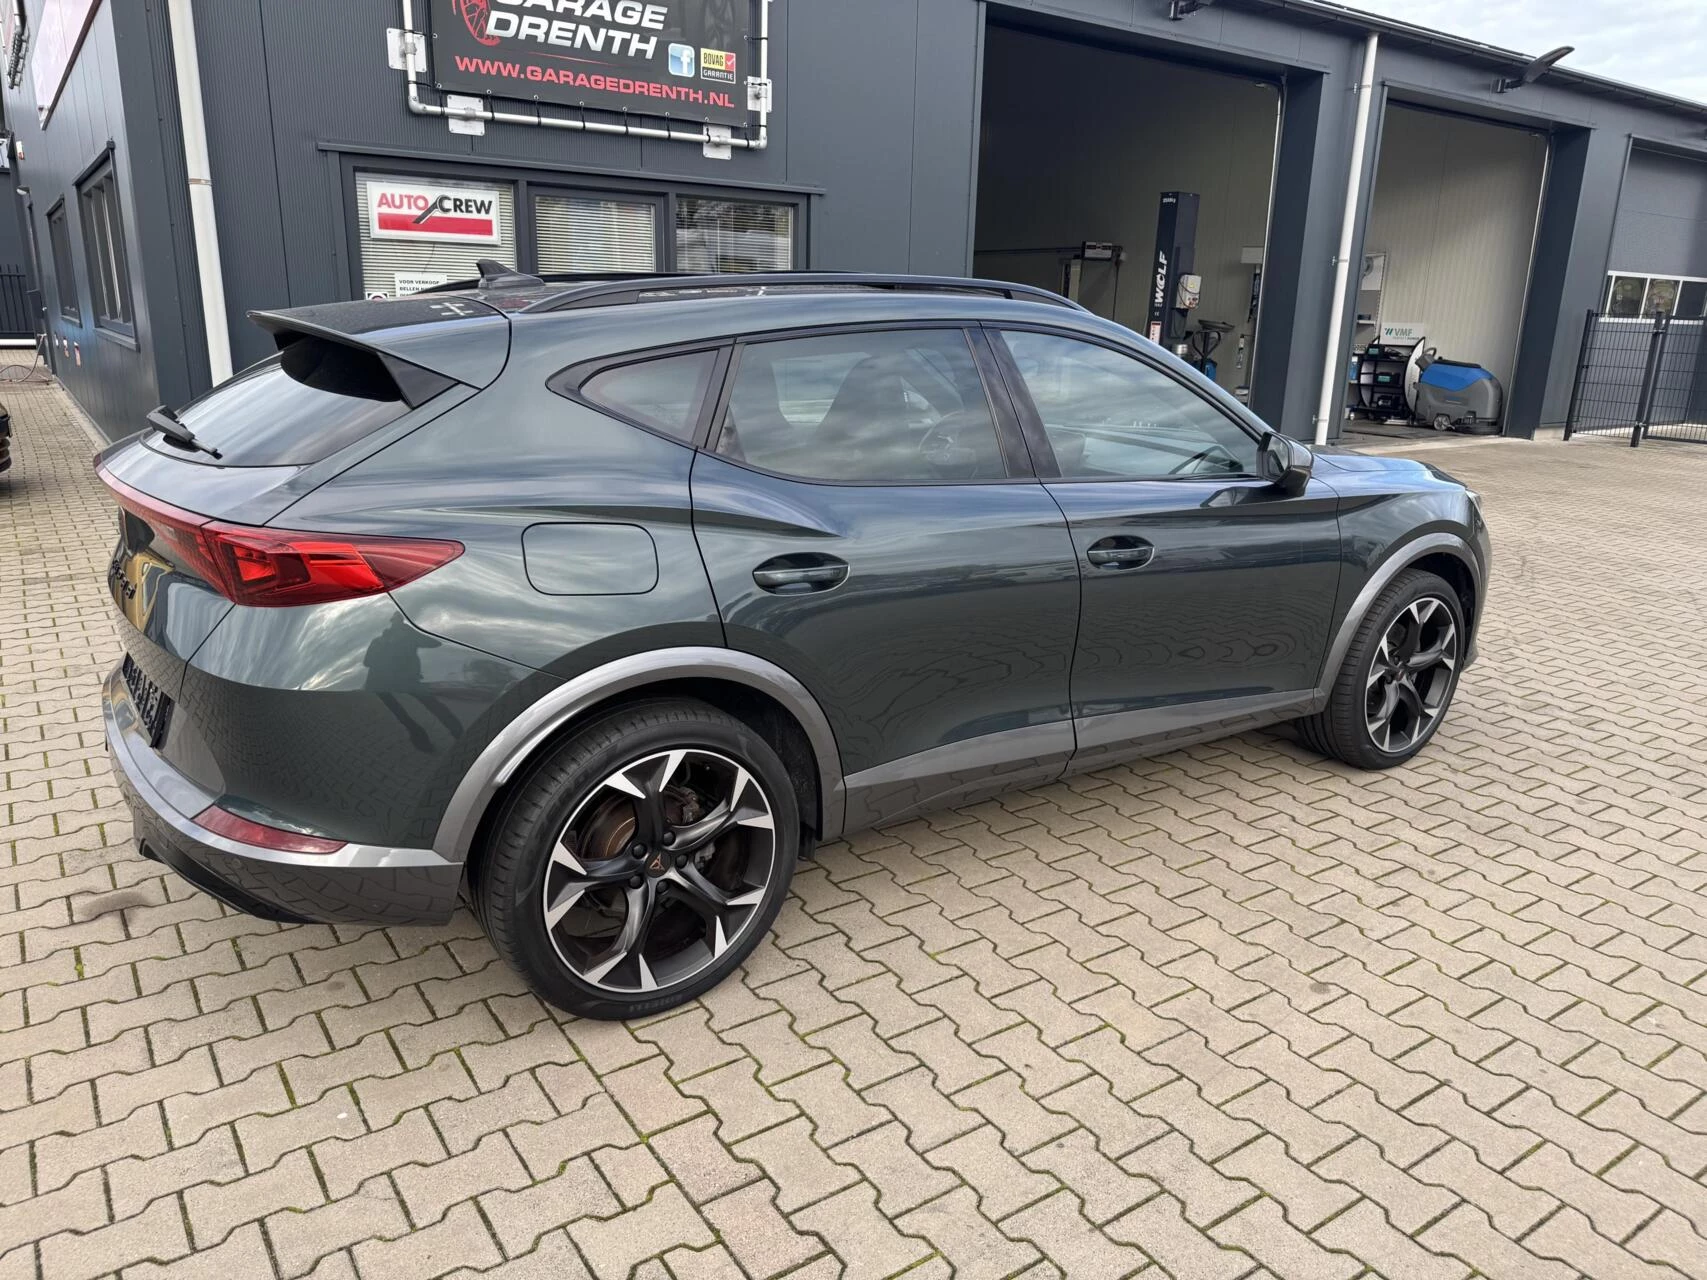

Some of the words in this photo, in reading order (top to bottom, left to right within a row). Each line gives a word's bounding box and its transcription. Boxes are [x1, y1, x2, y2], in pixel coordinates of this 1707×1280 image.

[496, 0, 668, 30] RAGE
[485, 10, 658, 59] DRENTH
[703, 52, 724, 67] BOVAG
[455, 56, 734, 107] WWW.GARAGEDRENTH.NL
[703, 69, 734, 81] GARANTIE
[377, 192, 429, 211] AUTO
[439, 195, 492, 215] CREW
[1154, 250, 1169, 304] WOLF
[1394, 327, 1413, 337] VMF
